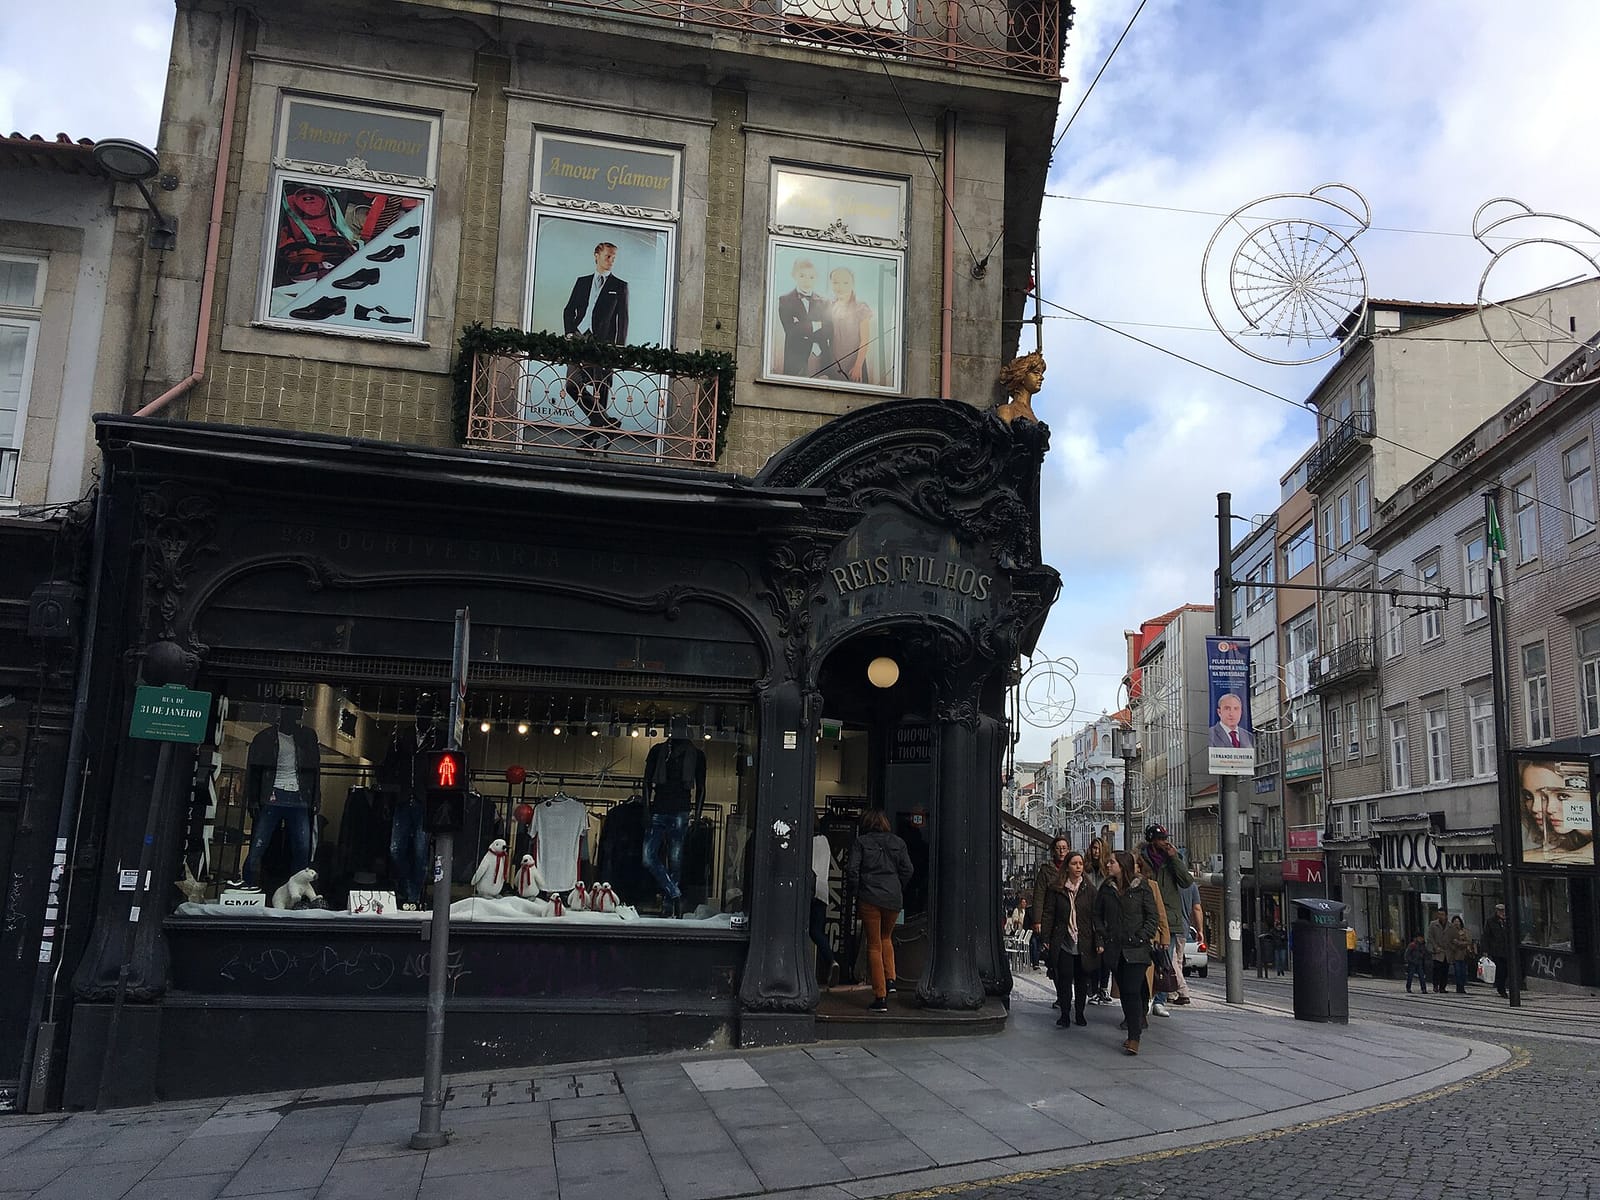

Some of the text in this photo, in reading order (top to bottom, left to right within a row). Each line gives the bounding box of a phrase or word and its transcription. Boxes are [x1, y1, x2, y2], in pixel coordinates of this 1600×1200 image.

[545, 157, 671, 191] Amour Glamour
[900, 555, 992, 600] FILHOS
[140, 705, 202, 718] 31 DE JANEIRO
